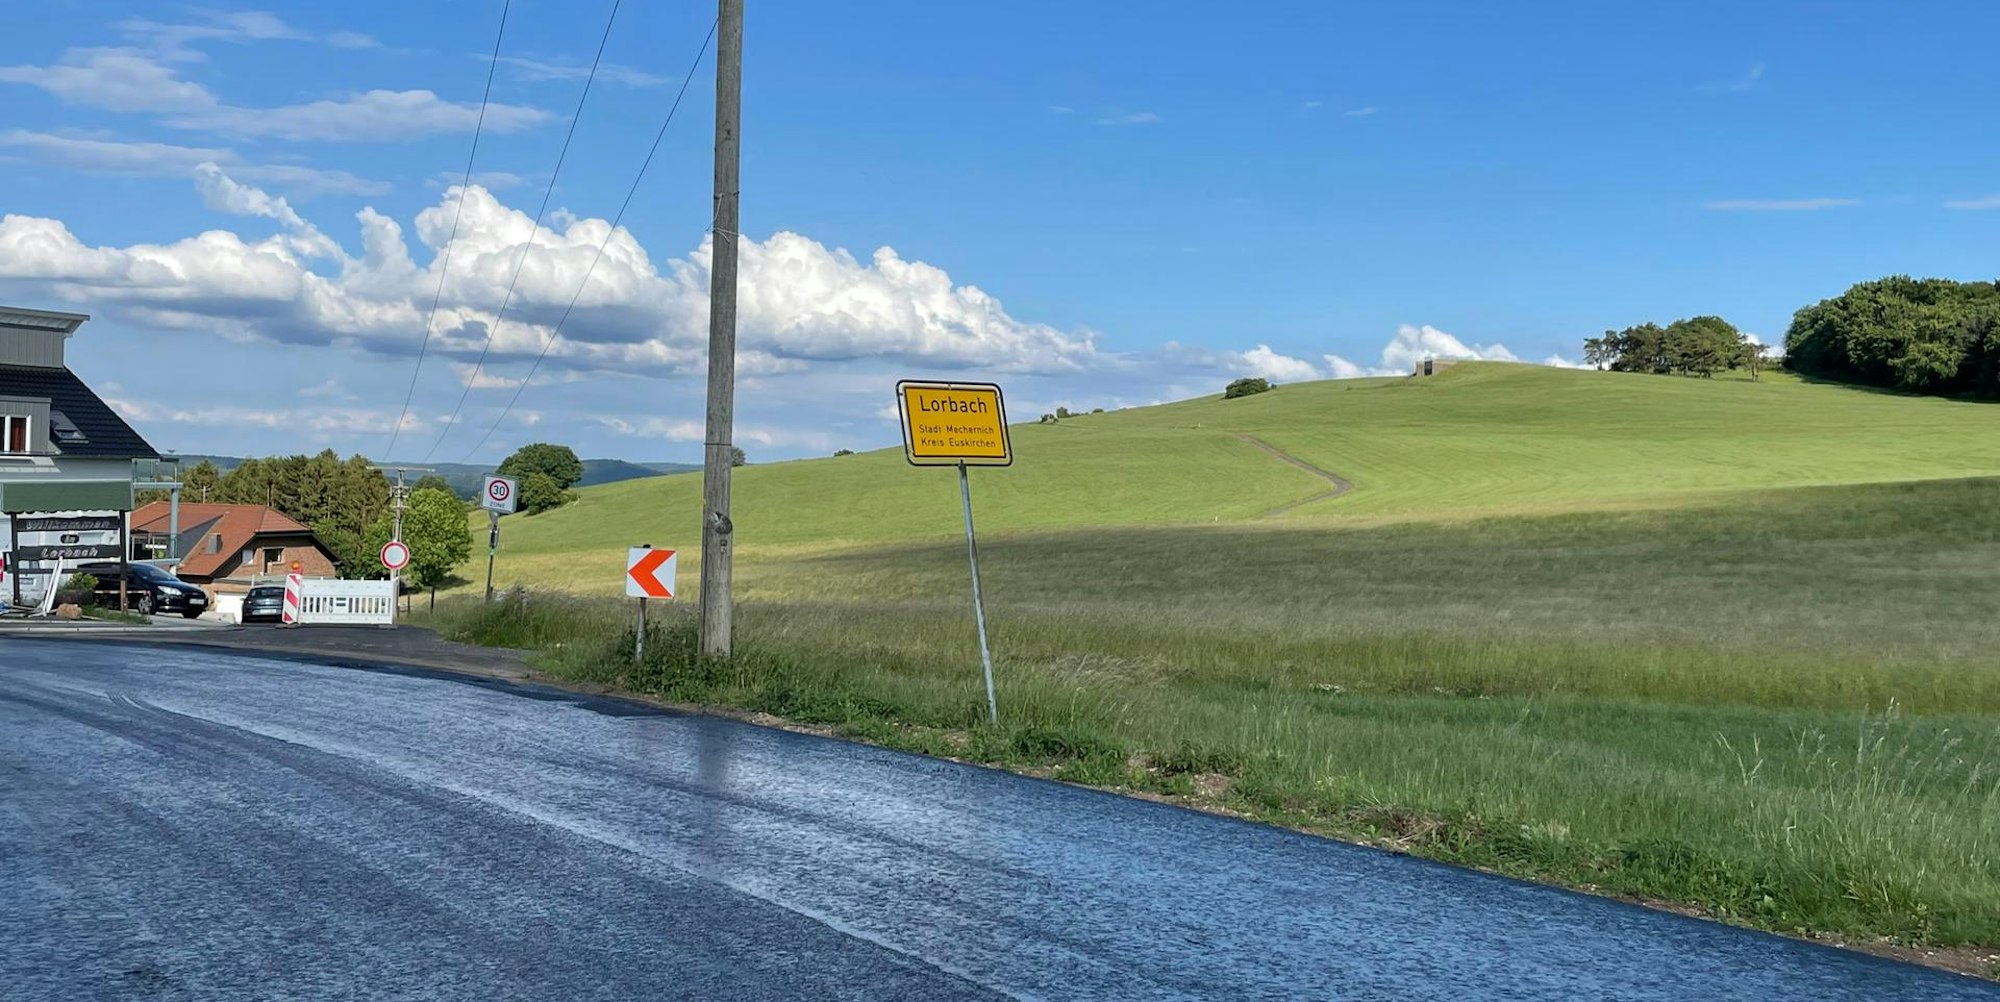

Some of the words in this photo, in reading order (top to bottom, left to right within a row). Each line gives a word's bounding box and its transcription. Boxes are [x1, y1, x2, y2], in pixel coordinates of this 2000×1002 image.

[919, 395, 987, 414] Lorbach
[918, 424, 941, 434] Stadt
[946, 424, 995, 435] Mechernich
[921, 437, 945, 447] Kreis
[948, 437, 996, 448] Euskirchen
[492, 485, 505, 496] 30
[40, 547, 99, 557] Lorbach
